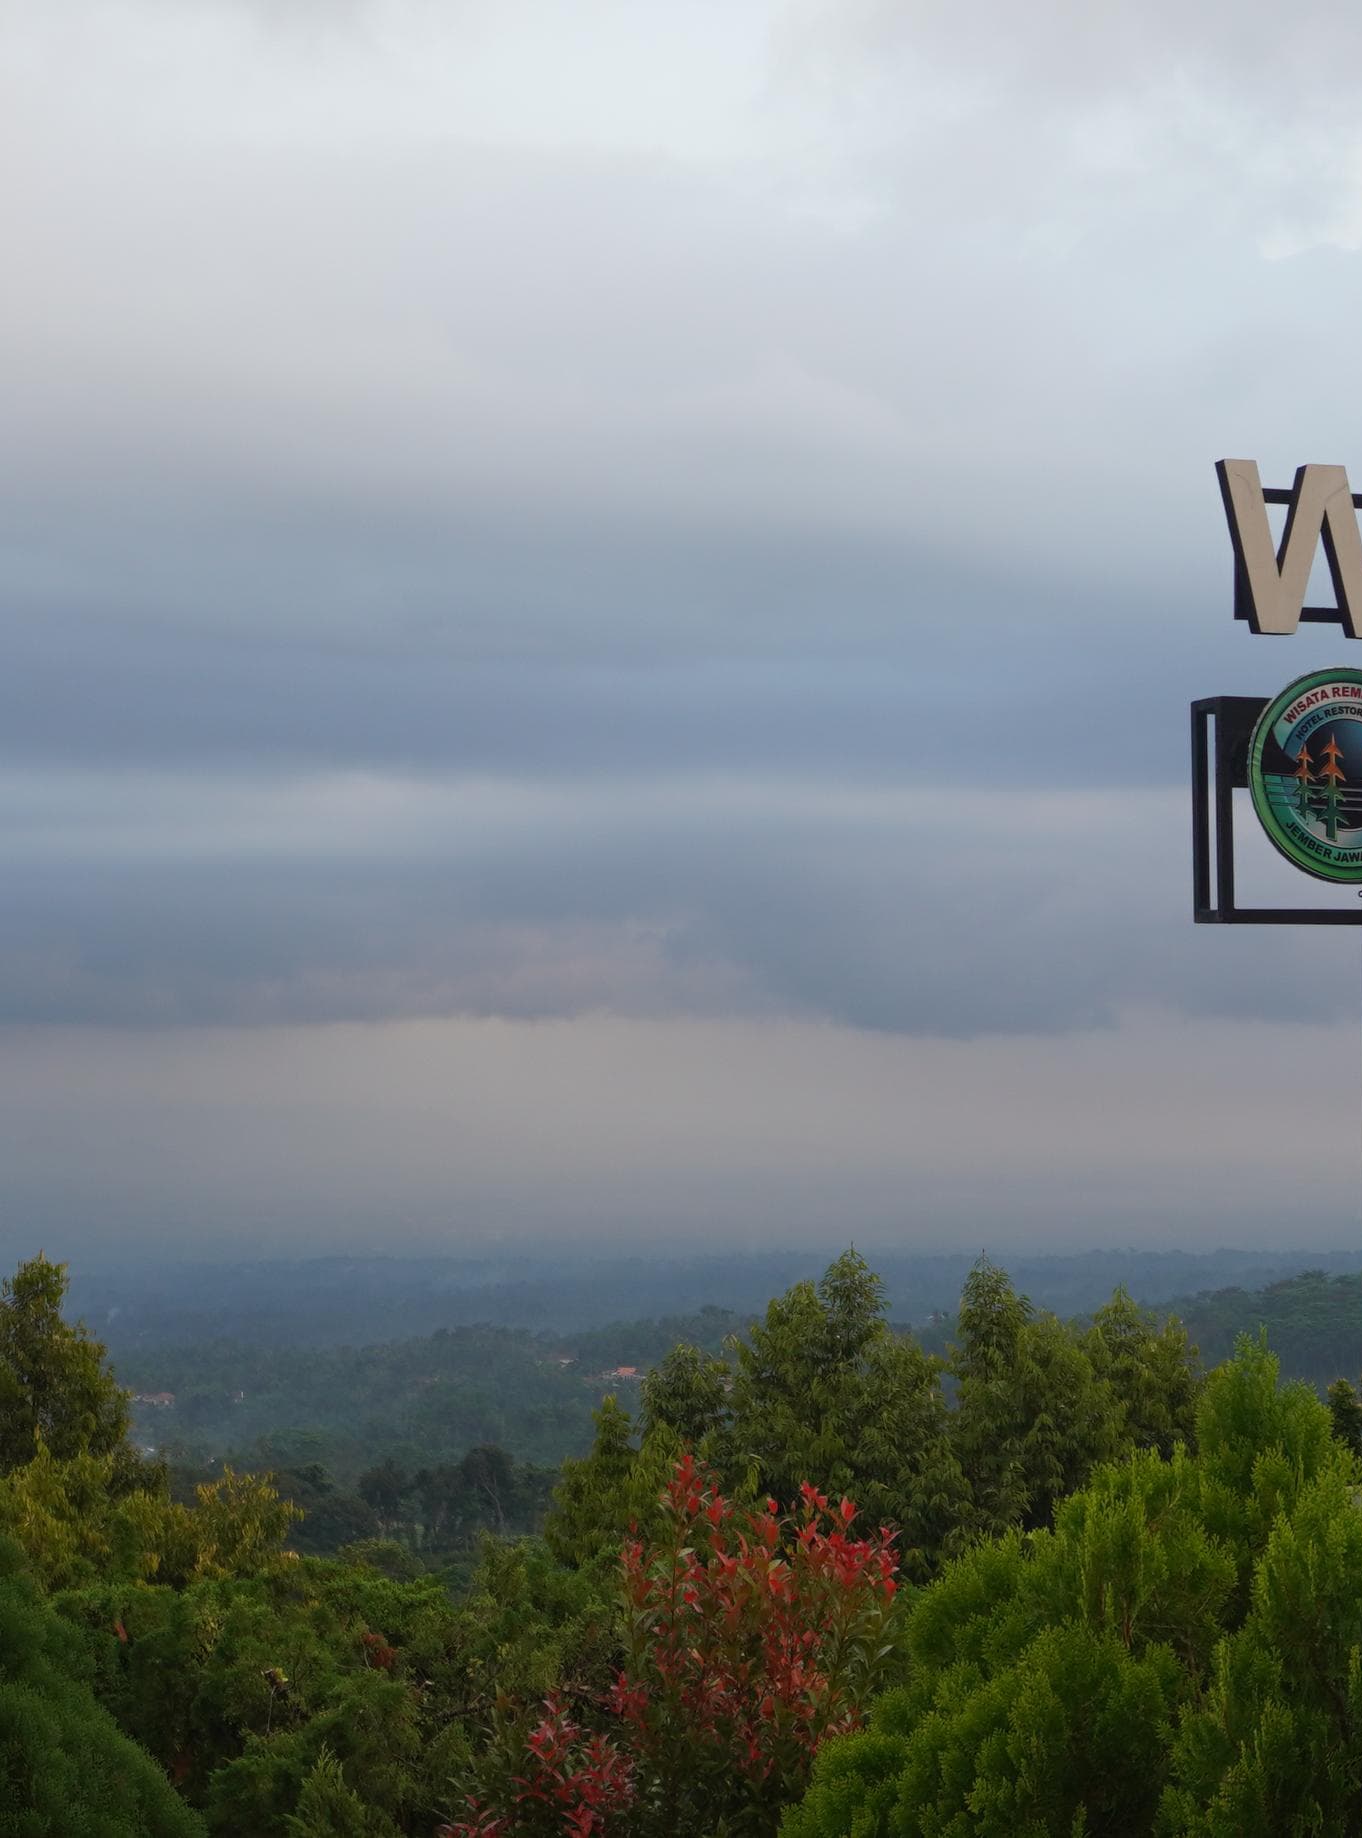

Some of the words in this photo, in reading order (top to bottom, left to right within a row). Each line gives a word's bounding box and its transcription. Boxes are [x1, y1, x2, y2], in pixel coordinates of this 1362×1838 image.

[1284, 688, 1330, 725] WISATA
[1295, 714, 1323, 740] HOTEL
[1286, 821, 1332, 860] JEMBER
